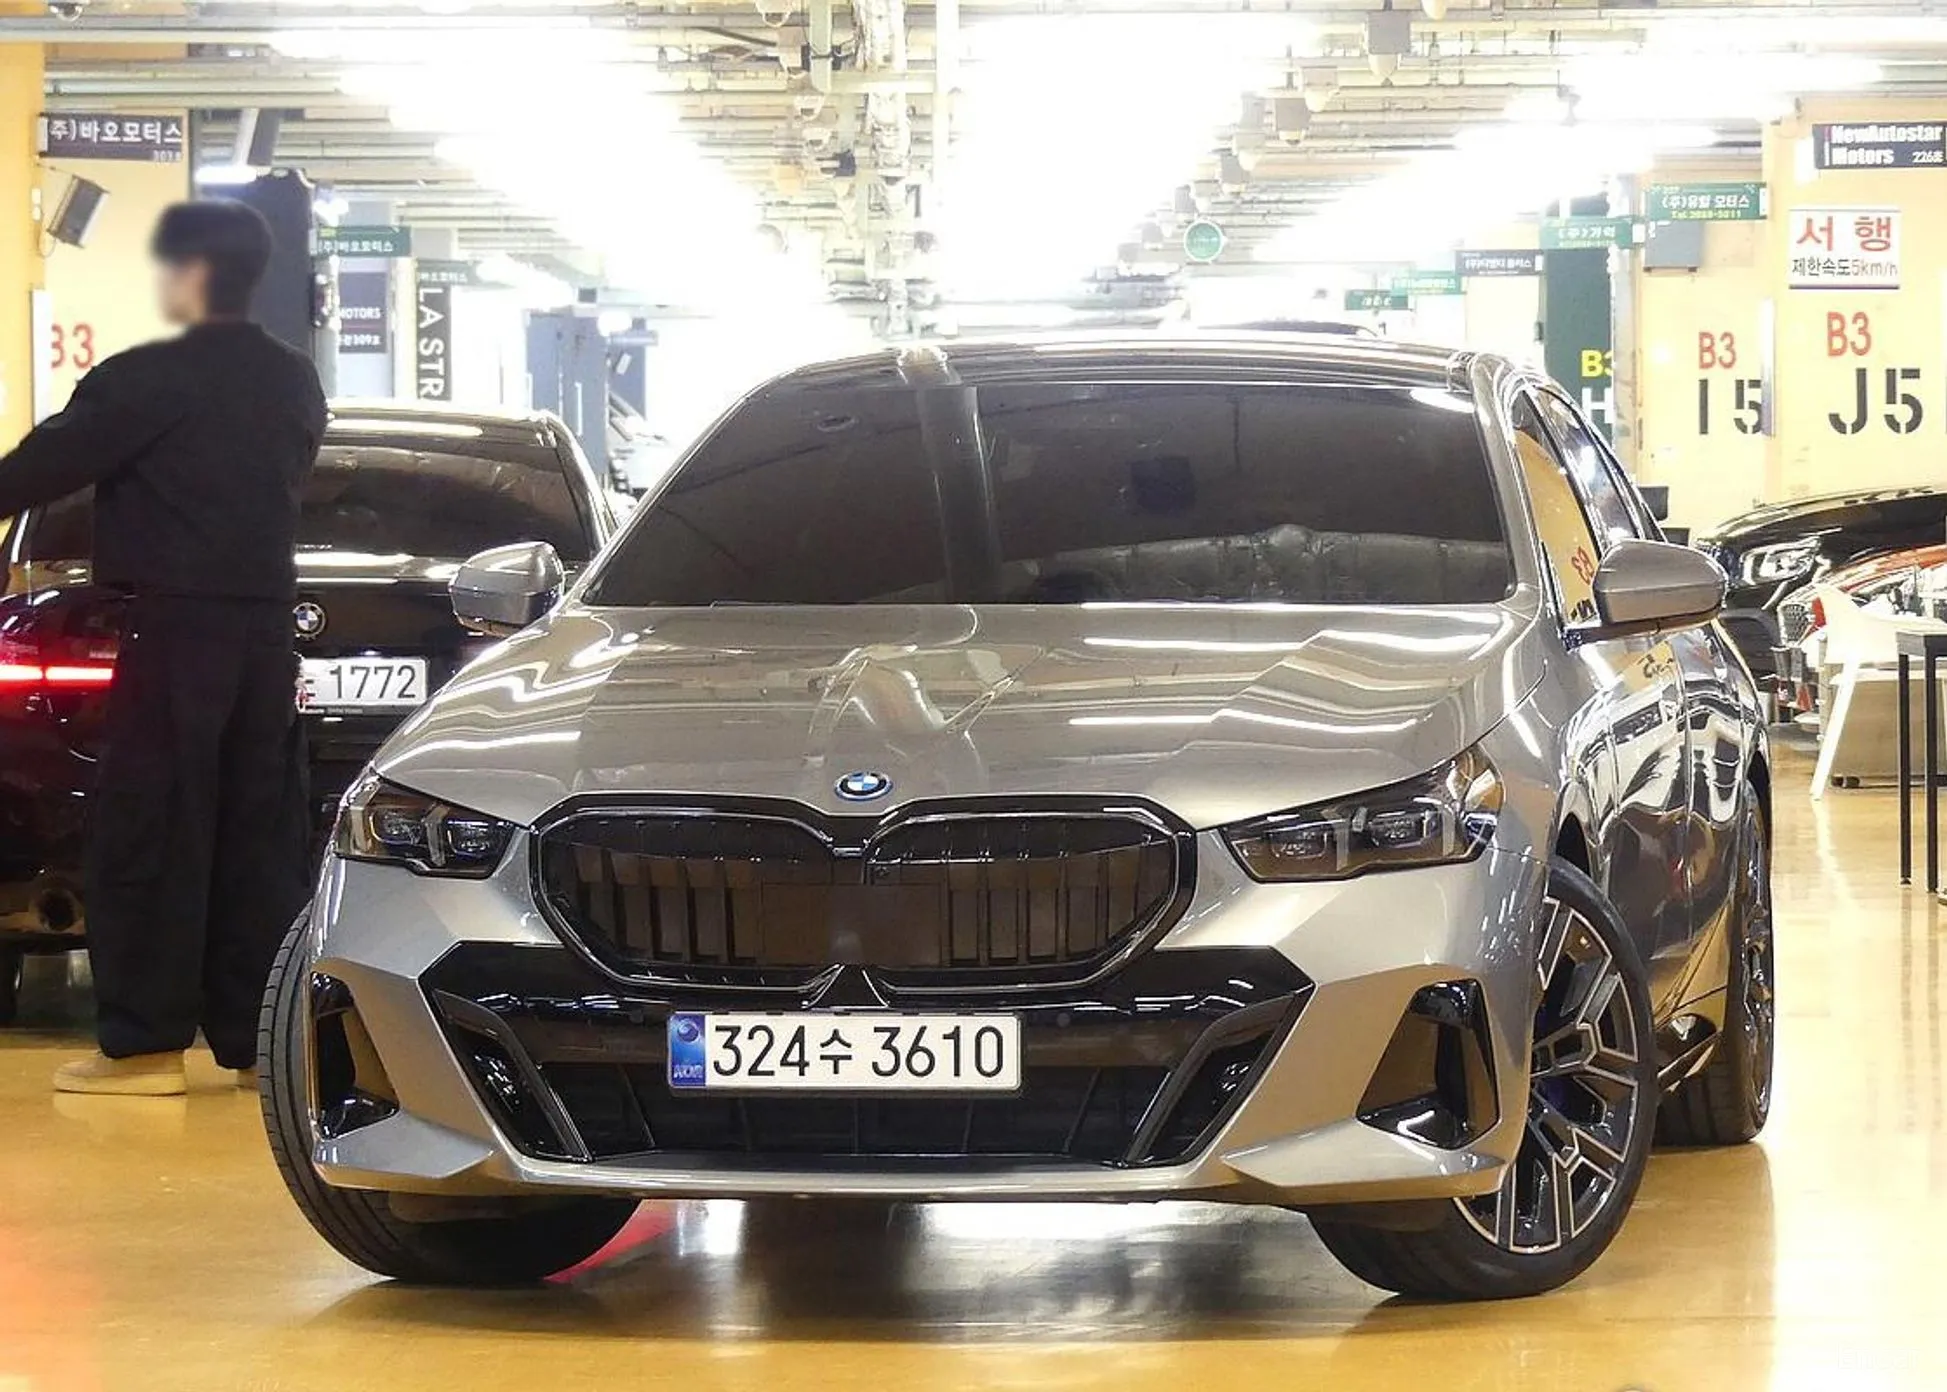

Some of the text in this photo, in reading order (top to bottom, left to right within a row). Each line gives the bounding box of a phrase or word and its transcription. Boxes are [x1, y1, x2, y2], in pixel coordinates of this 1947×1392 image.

[50, 119, 182, 144] 주)바오모터스
[1831, 125, 1943, 143] NewAutostar
[1832, 147, 1894, 166] Motors
[1698, 331, 1737, 369] B3
[1826, 311, 1872, 357] B3
[1828, 367, 1924, 435] J5
[329, 664, 417, 699] 1772
[712, 1025, 1004, 1078] 324수 3610
